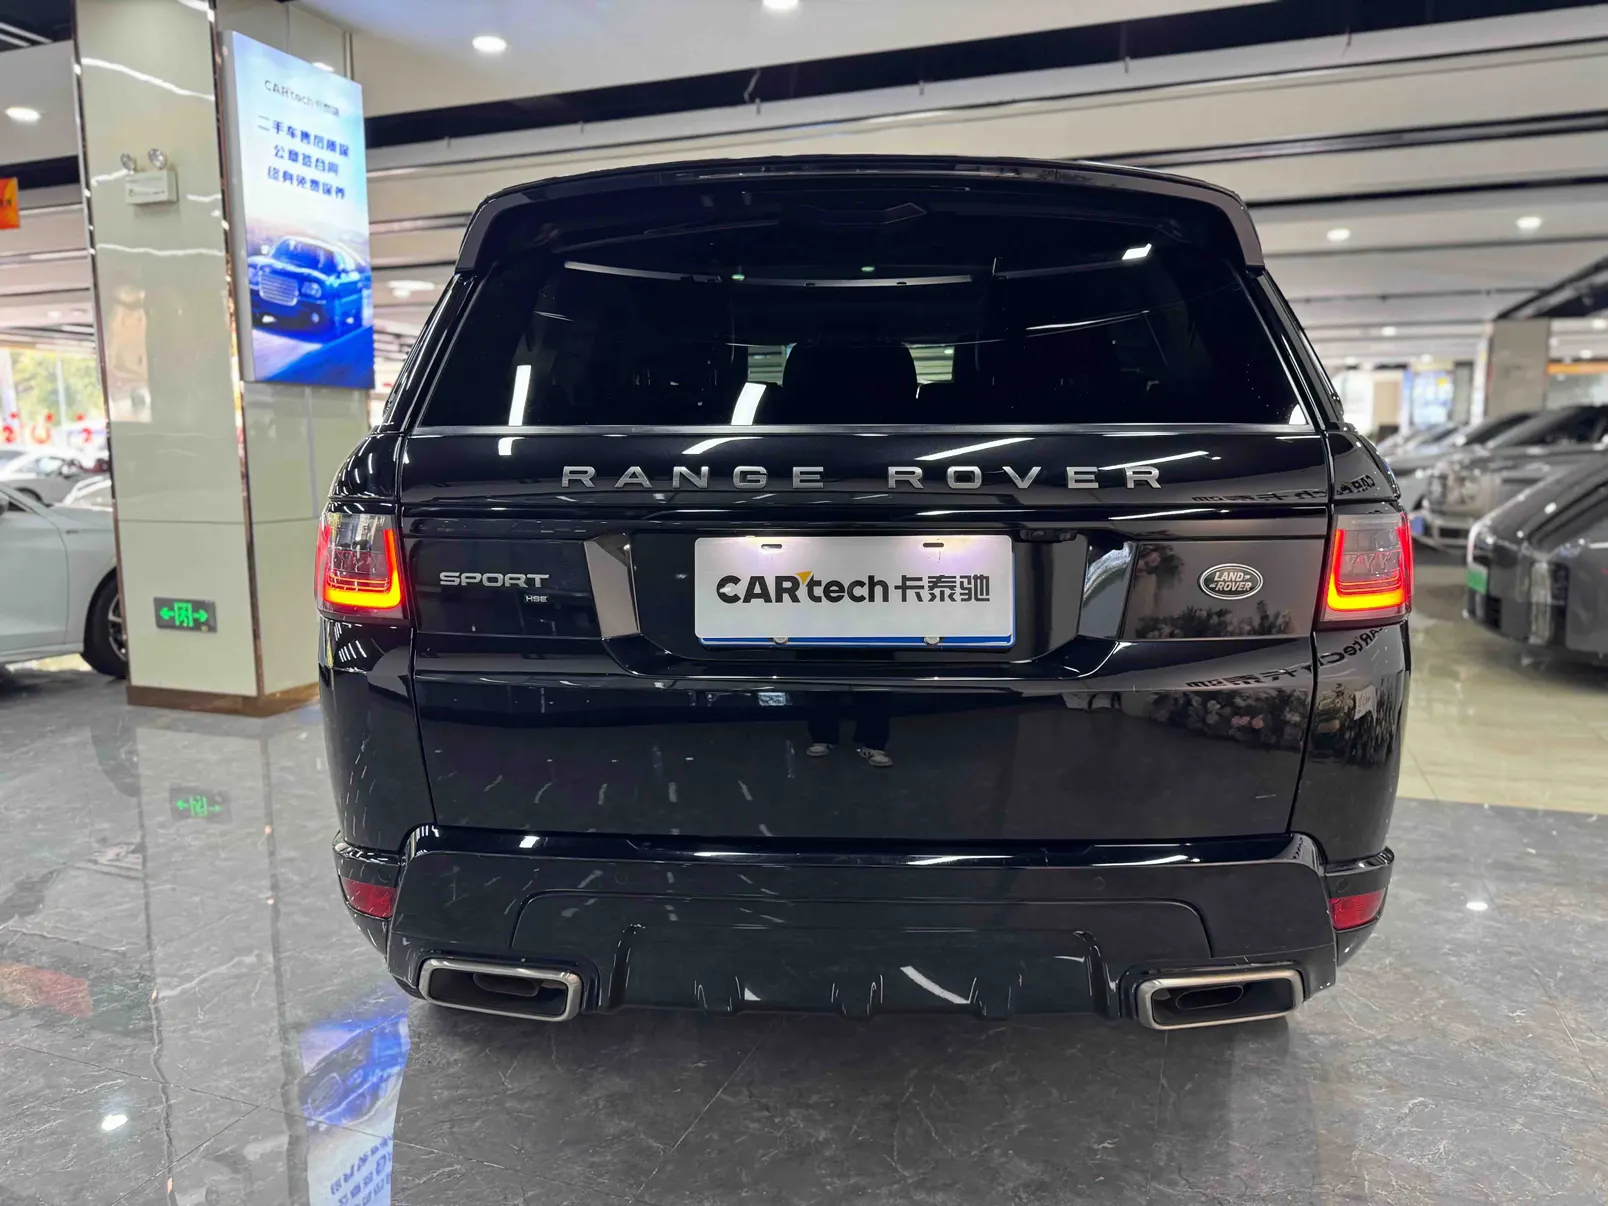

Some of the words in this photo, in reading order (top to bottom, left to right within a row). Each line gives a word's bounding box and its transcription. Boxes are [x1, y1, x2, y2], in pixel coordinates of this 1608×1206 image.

[561, 465, 825, 489] RANGE
[888, 465, 1162, 489] ROVER
[439, 571, 549, 588] SPORT
[1213, 571, 1244, 581] LAND
[894, 574, 990, 602] 卡泰驰
[1215, 582, 1252, 591] ROVER
